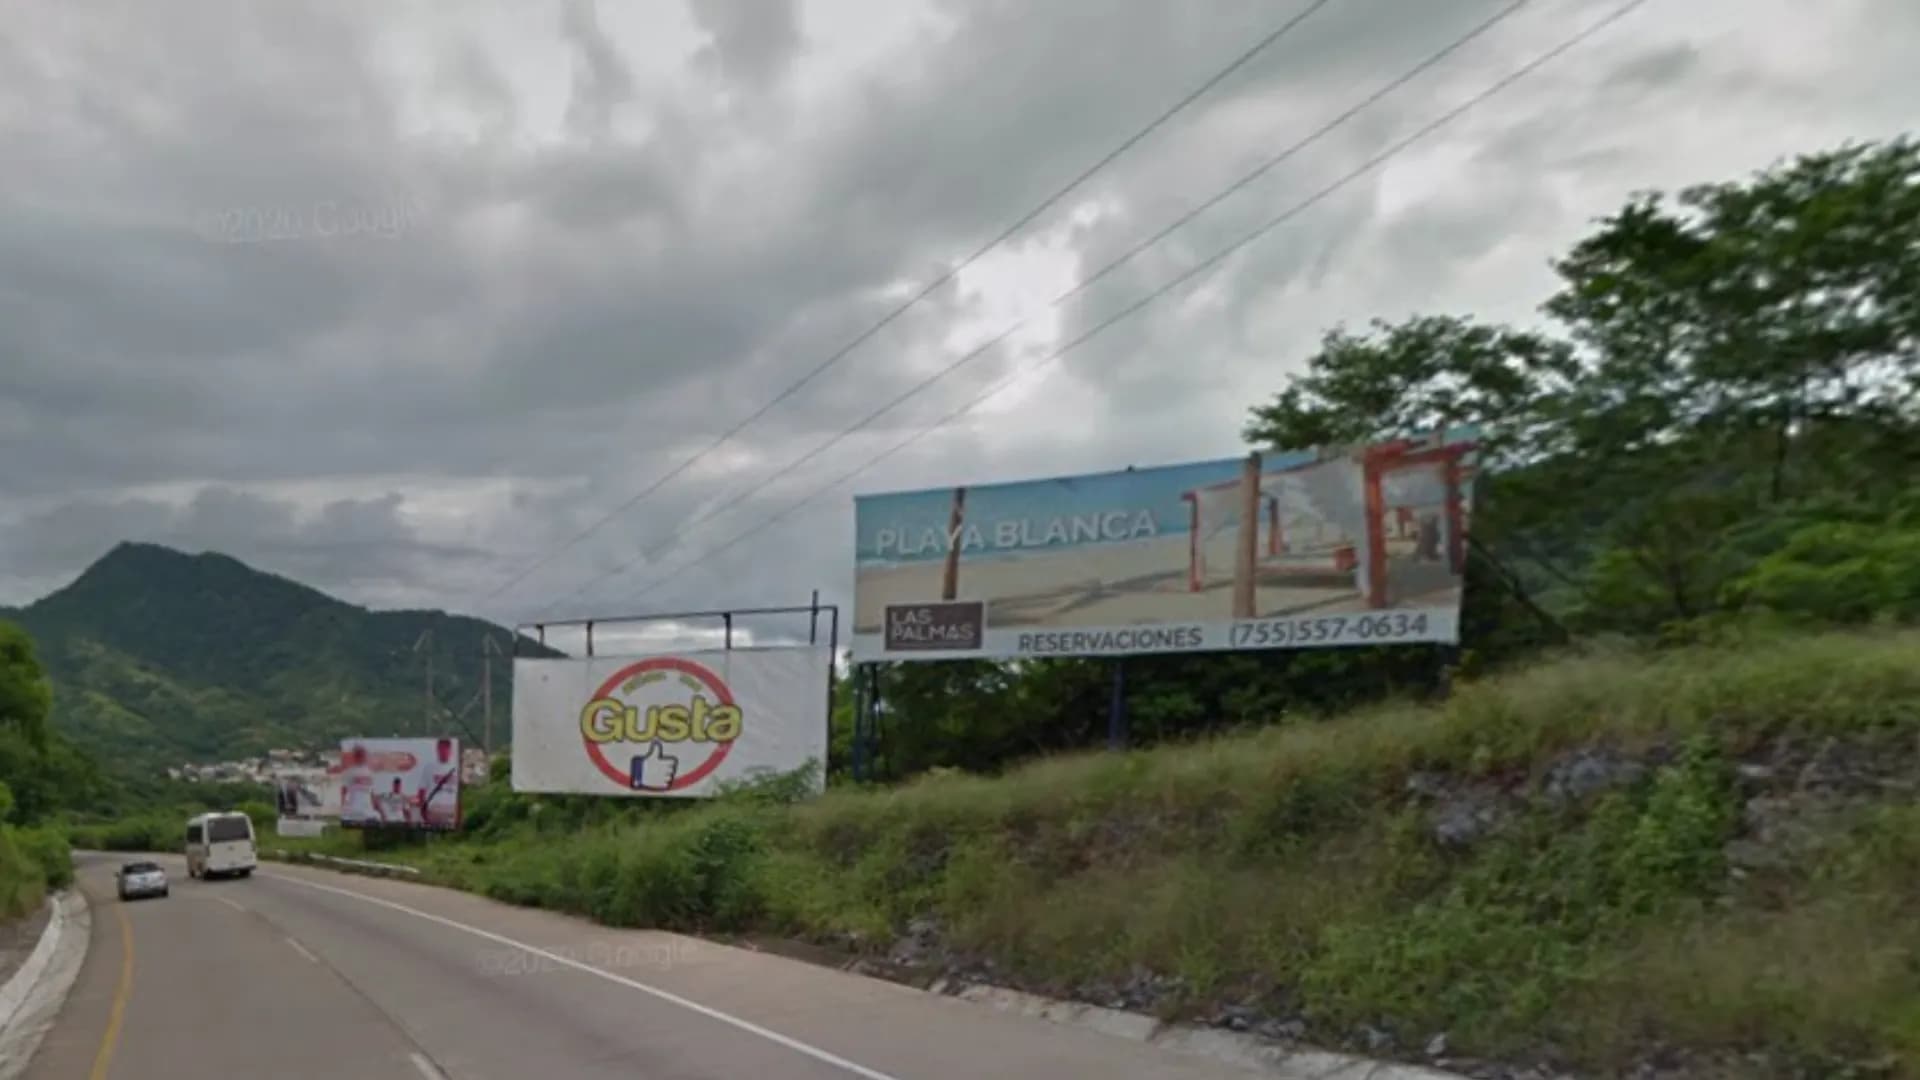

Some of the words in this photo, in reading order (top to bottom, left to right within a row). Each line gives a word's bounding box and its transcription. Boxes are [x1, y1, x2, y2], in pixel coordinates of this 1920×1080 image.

[875, 523, 984, 556] PLAYA
[994, 509, 1157, 548] BLANCA
[891, 608, 934, 625] LAS
[891, 622, 975, 642] PALMAS
[1018, 627, 1203, 653] RESERVACIONES
[1229, 613, 1428, 649] (755)557-0634
[580, 694, 743, 744] Gusta
